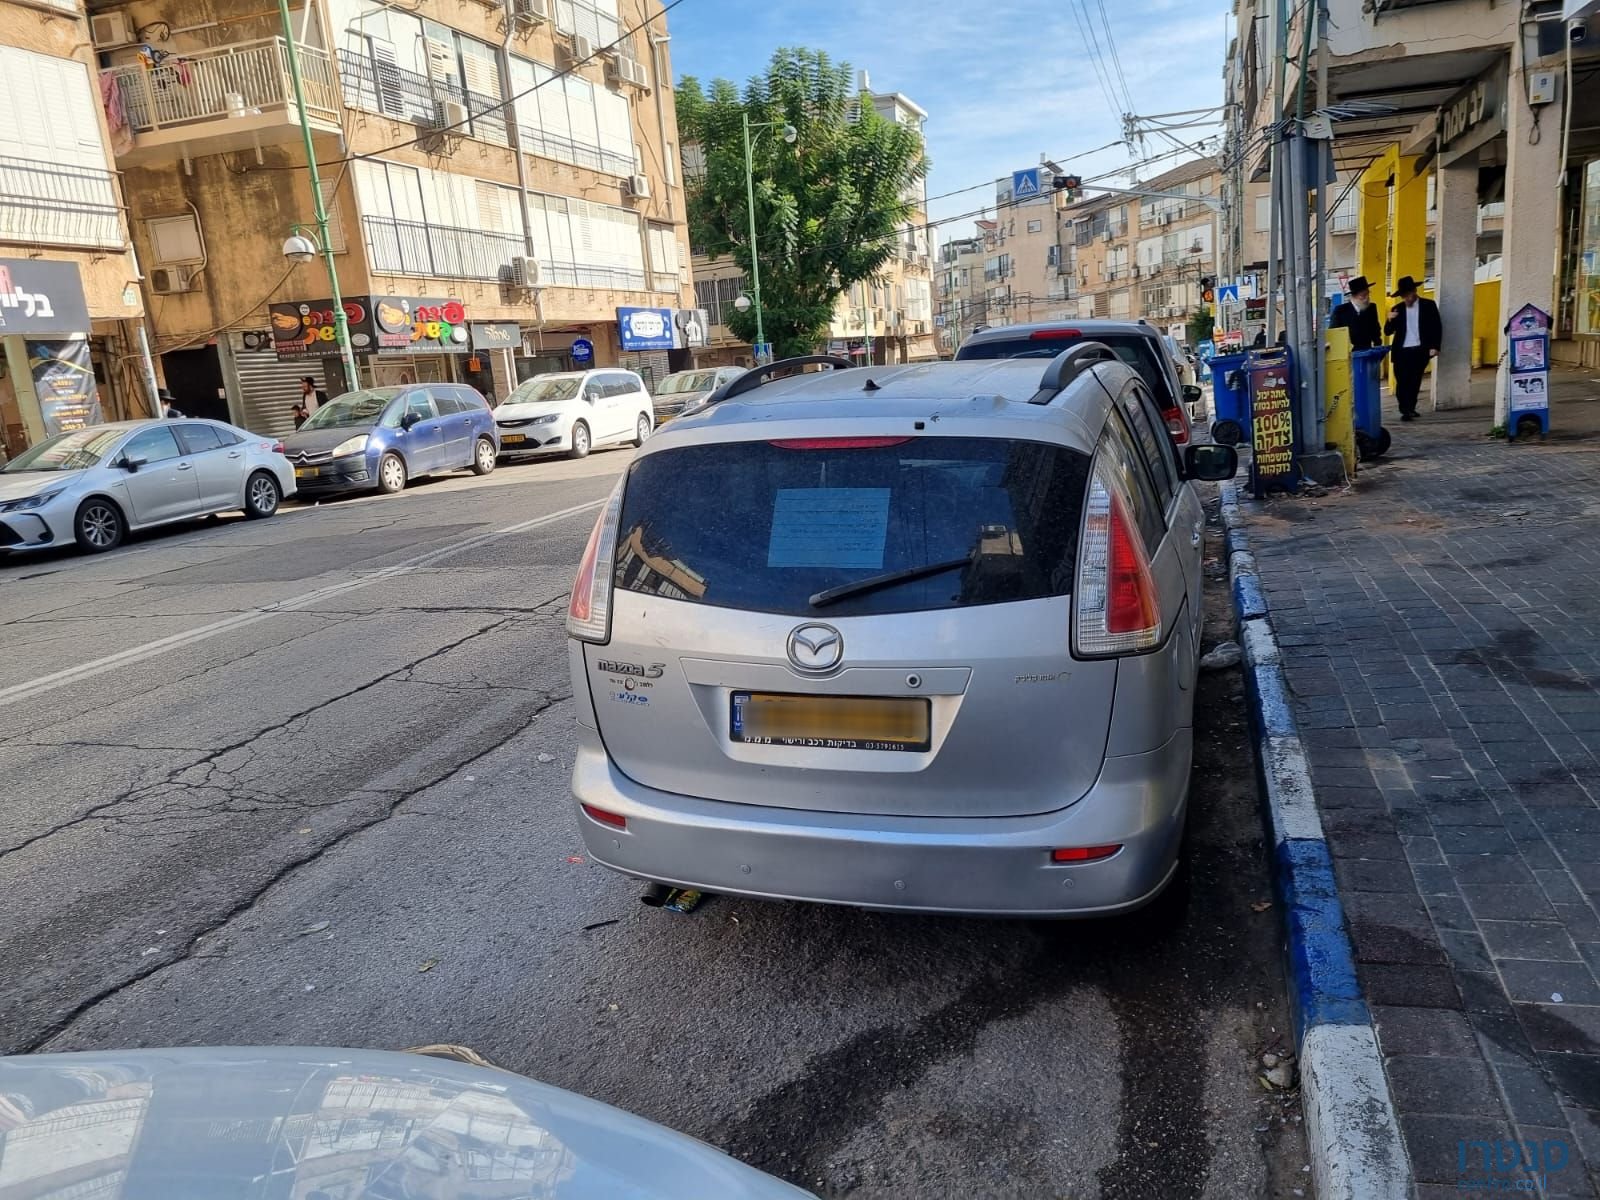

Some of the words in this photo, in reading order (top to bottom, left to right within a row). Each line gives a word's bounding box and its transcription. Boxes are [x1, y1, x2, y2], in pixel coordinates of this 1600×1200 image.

[1257, 390, 1270, 400] יכול
[1270, 389, 1287, 398] אתה
[1272, 398, 1290, 409] להיות
[1256, 412, 1291, 432] 100%
[1256, 430, 1292, 453] צדקה
[1257, 450, 1292, 464] למשפחות
[646, 662, 667, 679] 5
[782, 737, 806, 745] ורישוי
[808, 738, 824, 746] רכב
[827, 739, 857, 749] בדיקות
